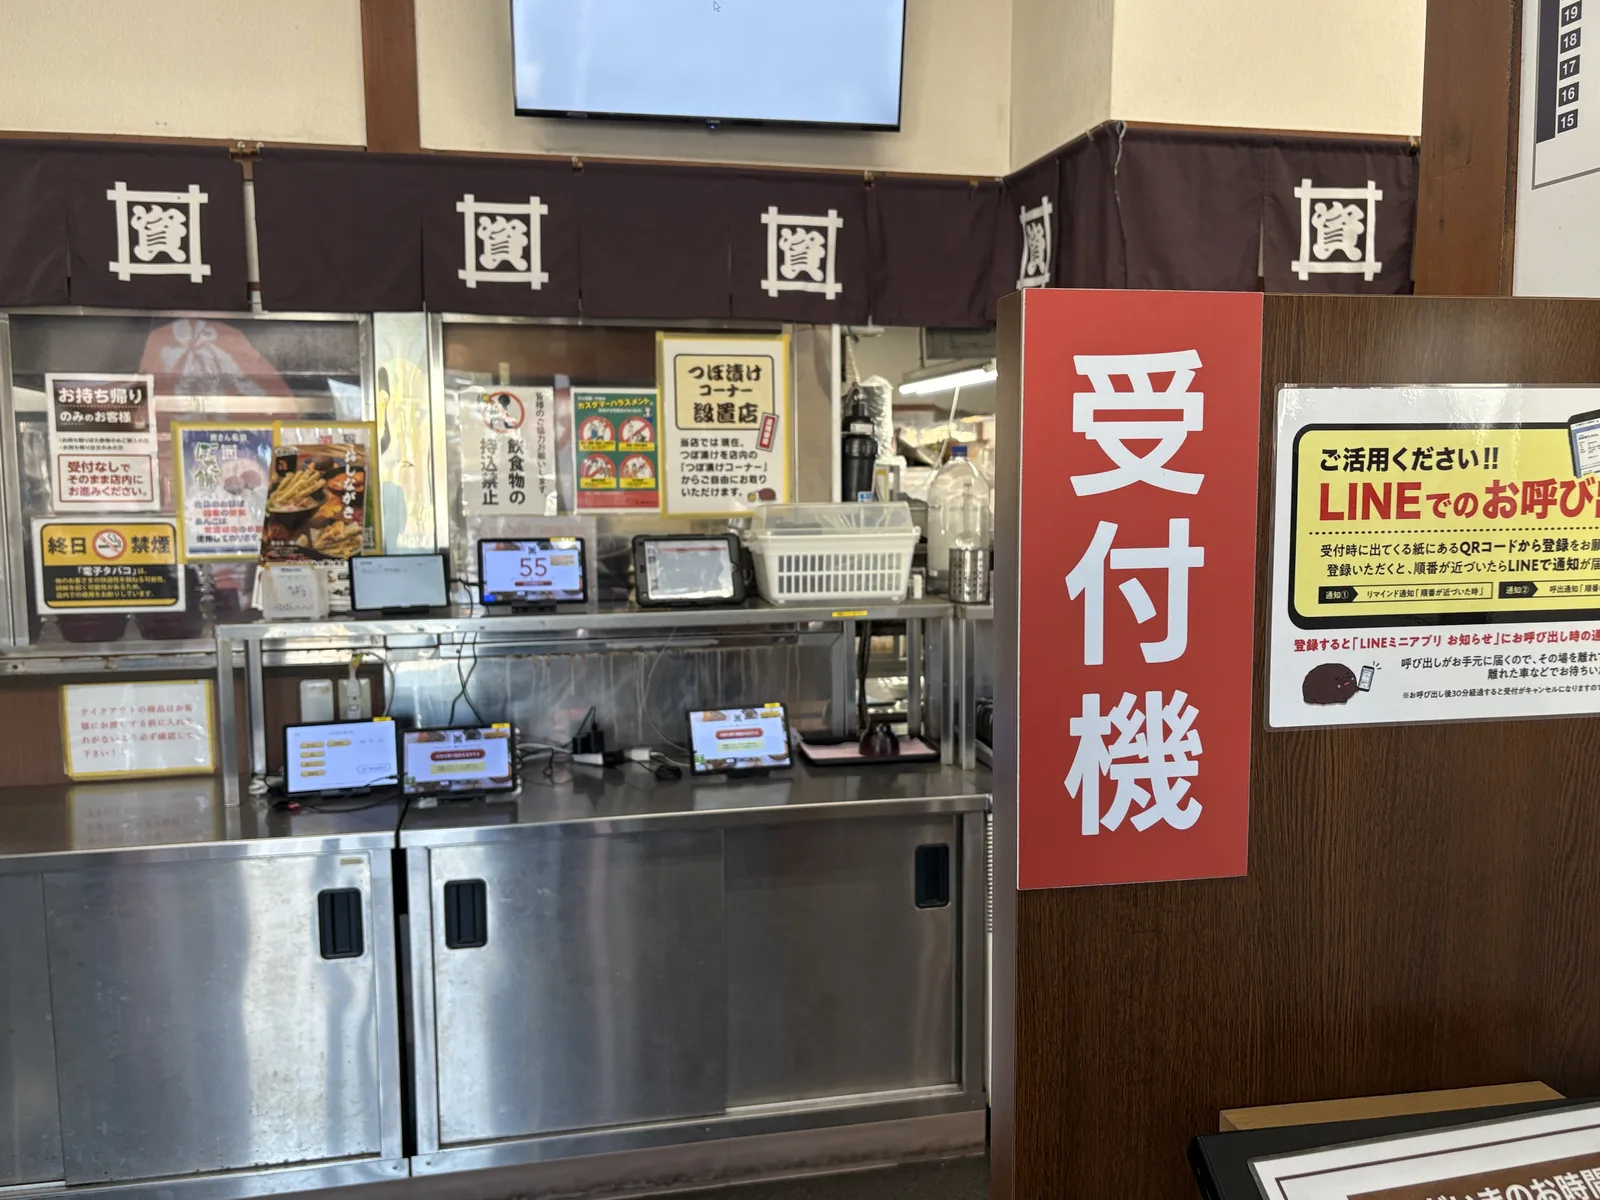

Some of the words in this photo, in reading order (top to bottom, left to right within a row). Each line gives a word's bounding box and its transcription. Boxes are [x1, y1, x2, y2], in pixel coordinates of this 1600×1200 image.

[1564, 6, 1578, 21] 19
[1563, 33, 1577, 48] 18
[1562, 60, 1576, 76] 17
[1561, 87, 1575, 102] 16
[1560, 114, 1574, 129] 15
[688, 364, 762, 382] つぼ漬け
[58, 387, 142, 404] お持ち帰り
[699, 384, 753, 397] コーナー
[60, 411, 131, 423] のみのお客様
[693, 402, 759, 423] 設置店
[681, 451, 758, 460] つぼ漬けを店内の
[67, 461, 131, 473] 受付なしで
[480, 438, 499, 505] 持込禁止
[508, 438, 525, 505] 飲食物の
[68, 474, 143, 485] そのまま店内に
[342, 449, 356, 519] おしながき
[681, 475, 767, 485] からご自由にお取り
[69, 486, 148, 497] お進みください。
[681, 488, 743, 497] いただけます。
[1319, 477, 1600, 521] LINEでのお呼び
[48, 536, 87, 555] 終日
[131, 535, 170, 554] 禁煙
[520, 557, 547, 577] 55
[1064, 349, 1204, 836] 受付機
[1549, 584, 1600, 594] 呼出通知「順番
[1294, 635, 1442, 652] 登録すると「LINEミニアプリ
[1401, 651, 1600, 669] 呼び出しがお手元に届くので、その場を離れ
[1487, 665, 1600, 680] 離れた車などでお待ちい
[1426, 1167, 1600, 1200] のお時間
